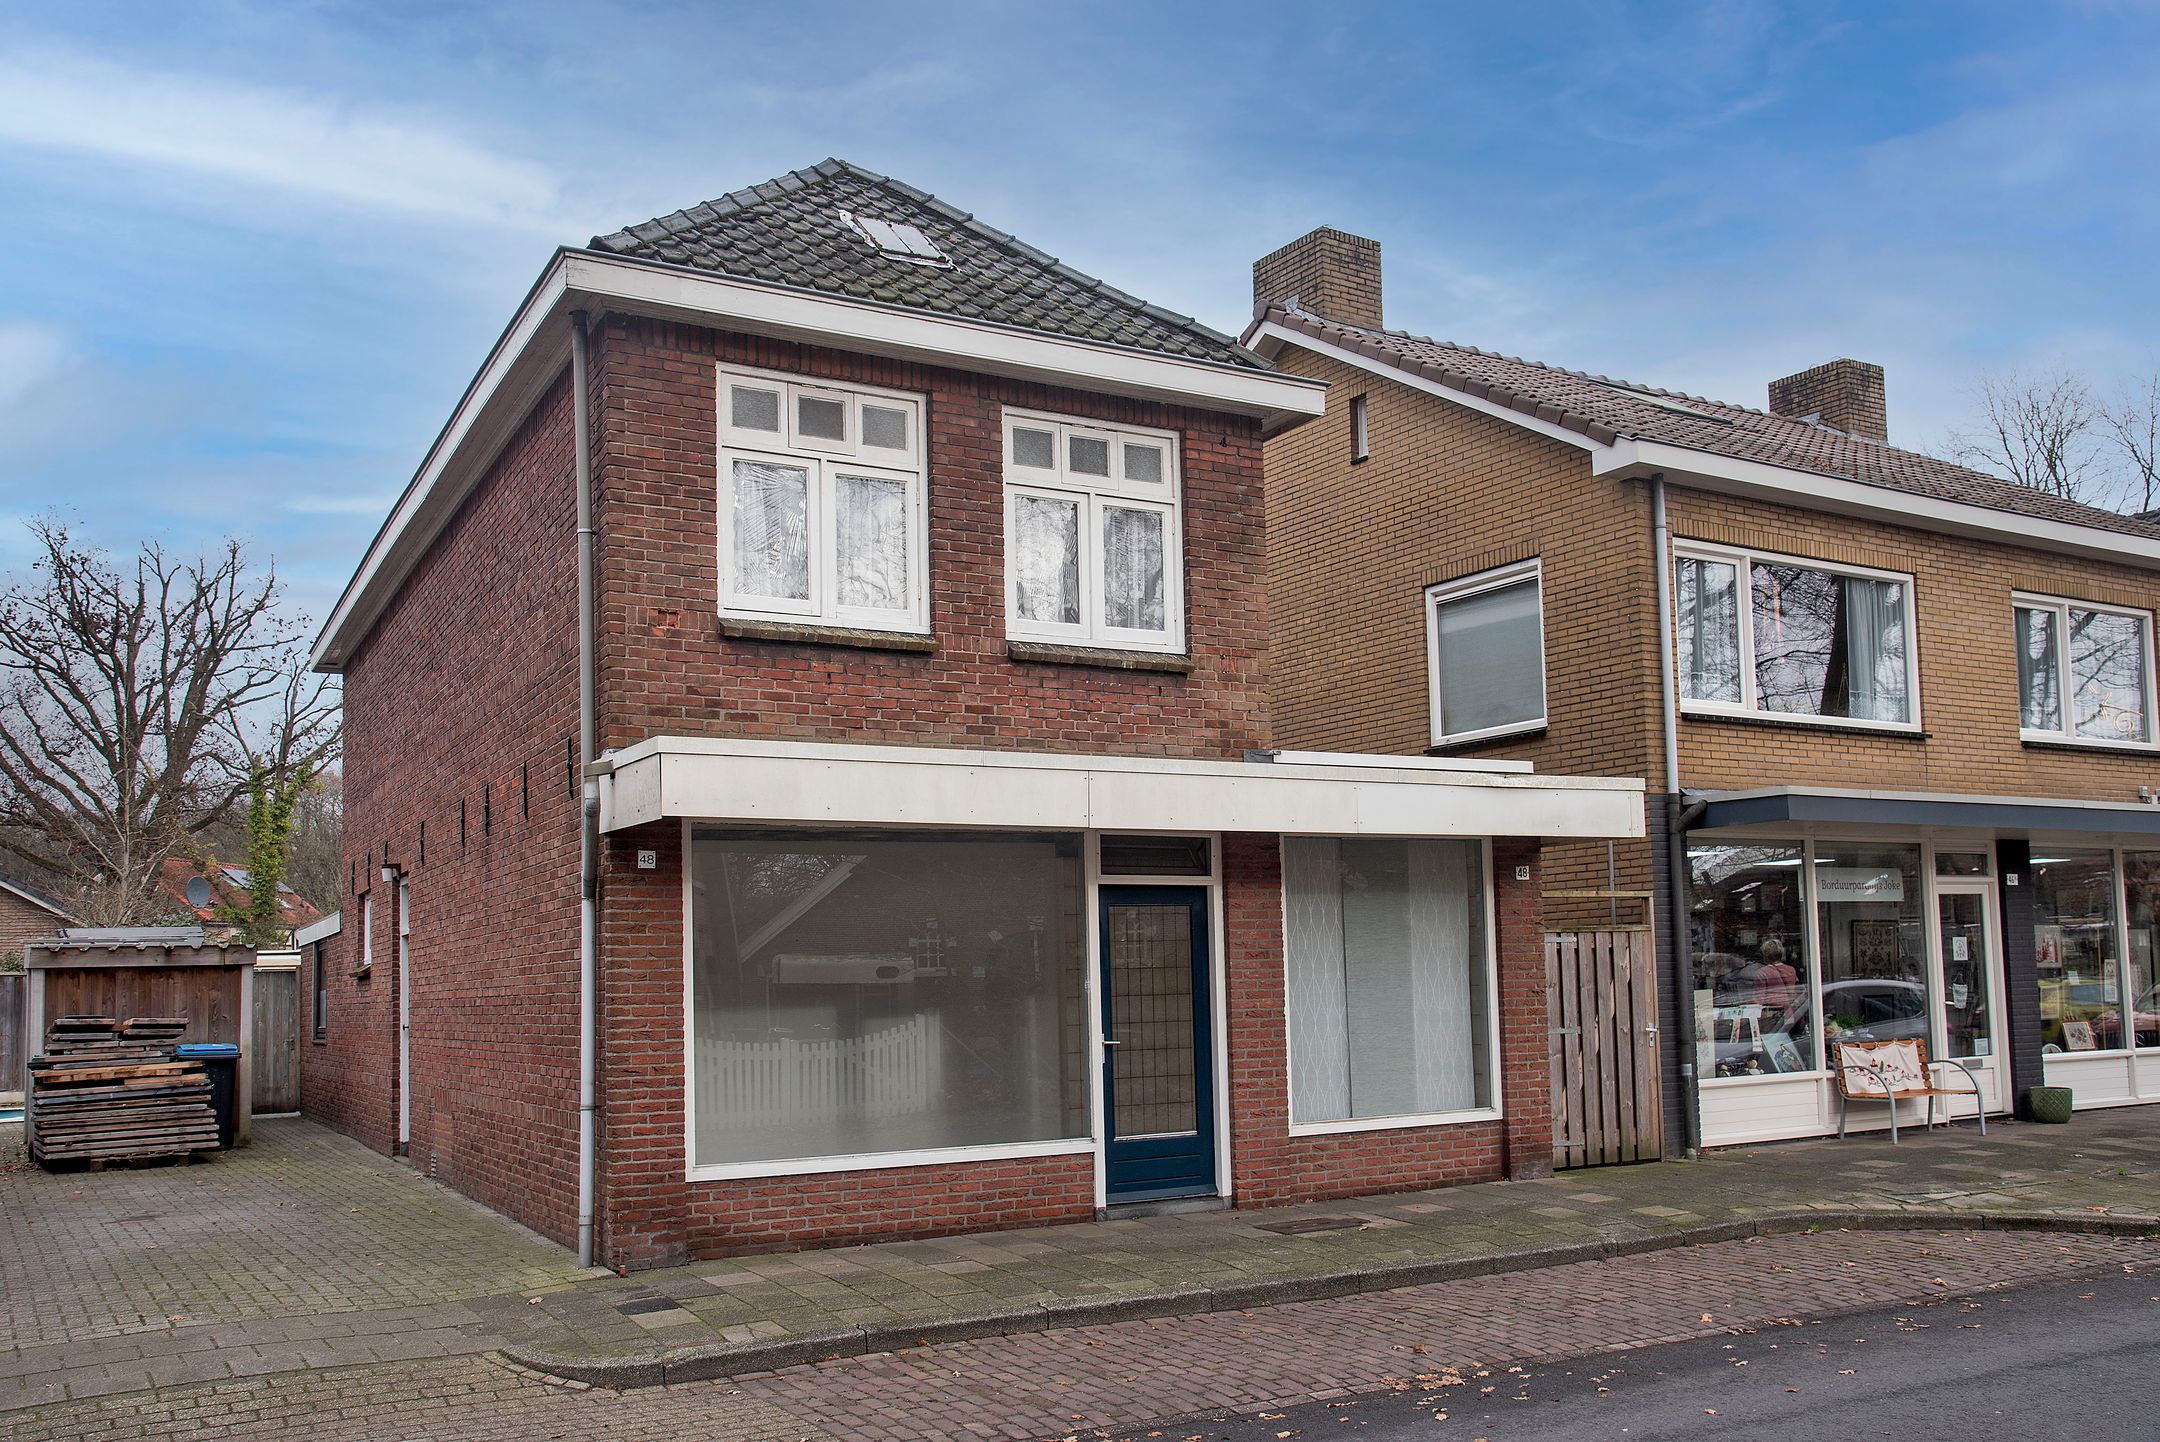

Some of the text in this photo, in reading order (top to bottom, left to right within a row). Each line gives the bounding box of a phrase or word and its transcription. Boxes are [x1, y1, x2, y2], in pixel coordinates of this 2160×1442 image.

[639, 854, 655, 865] 48
[1517, 867, 1528, 878] 48
[1883, 879, 1901, 890] Joke
